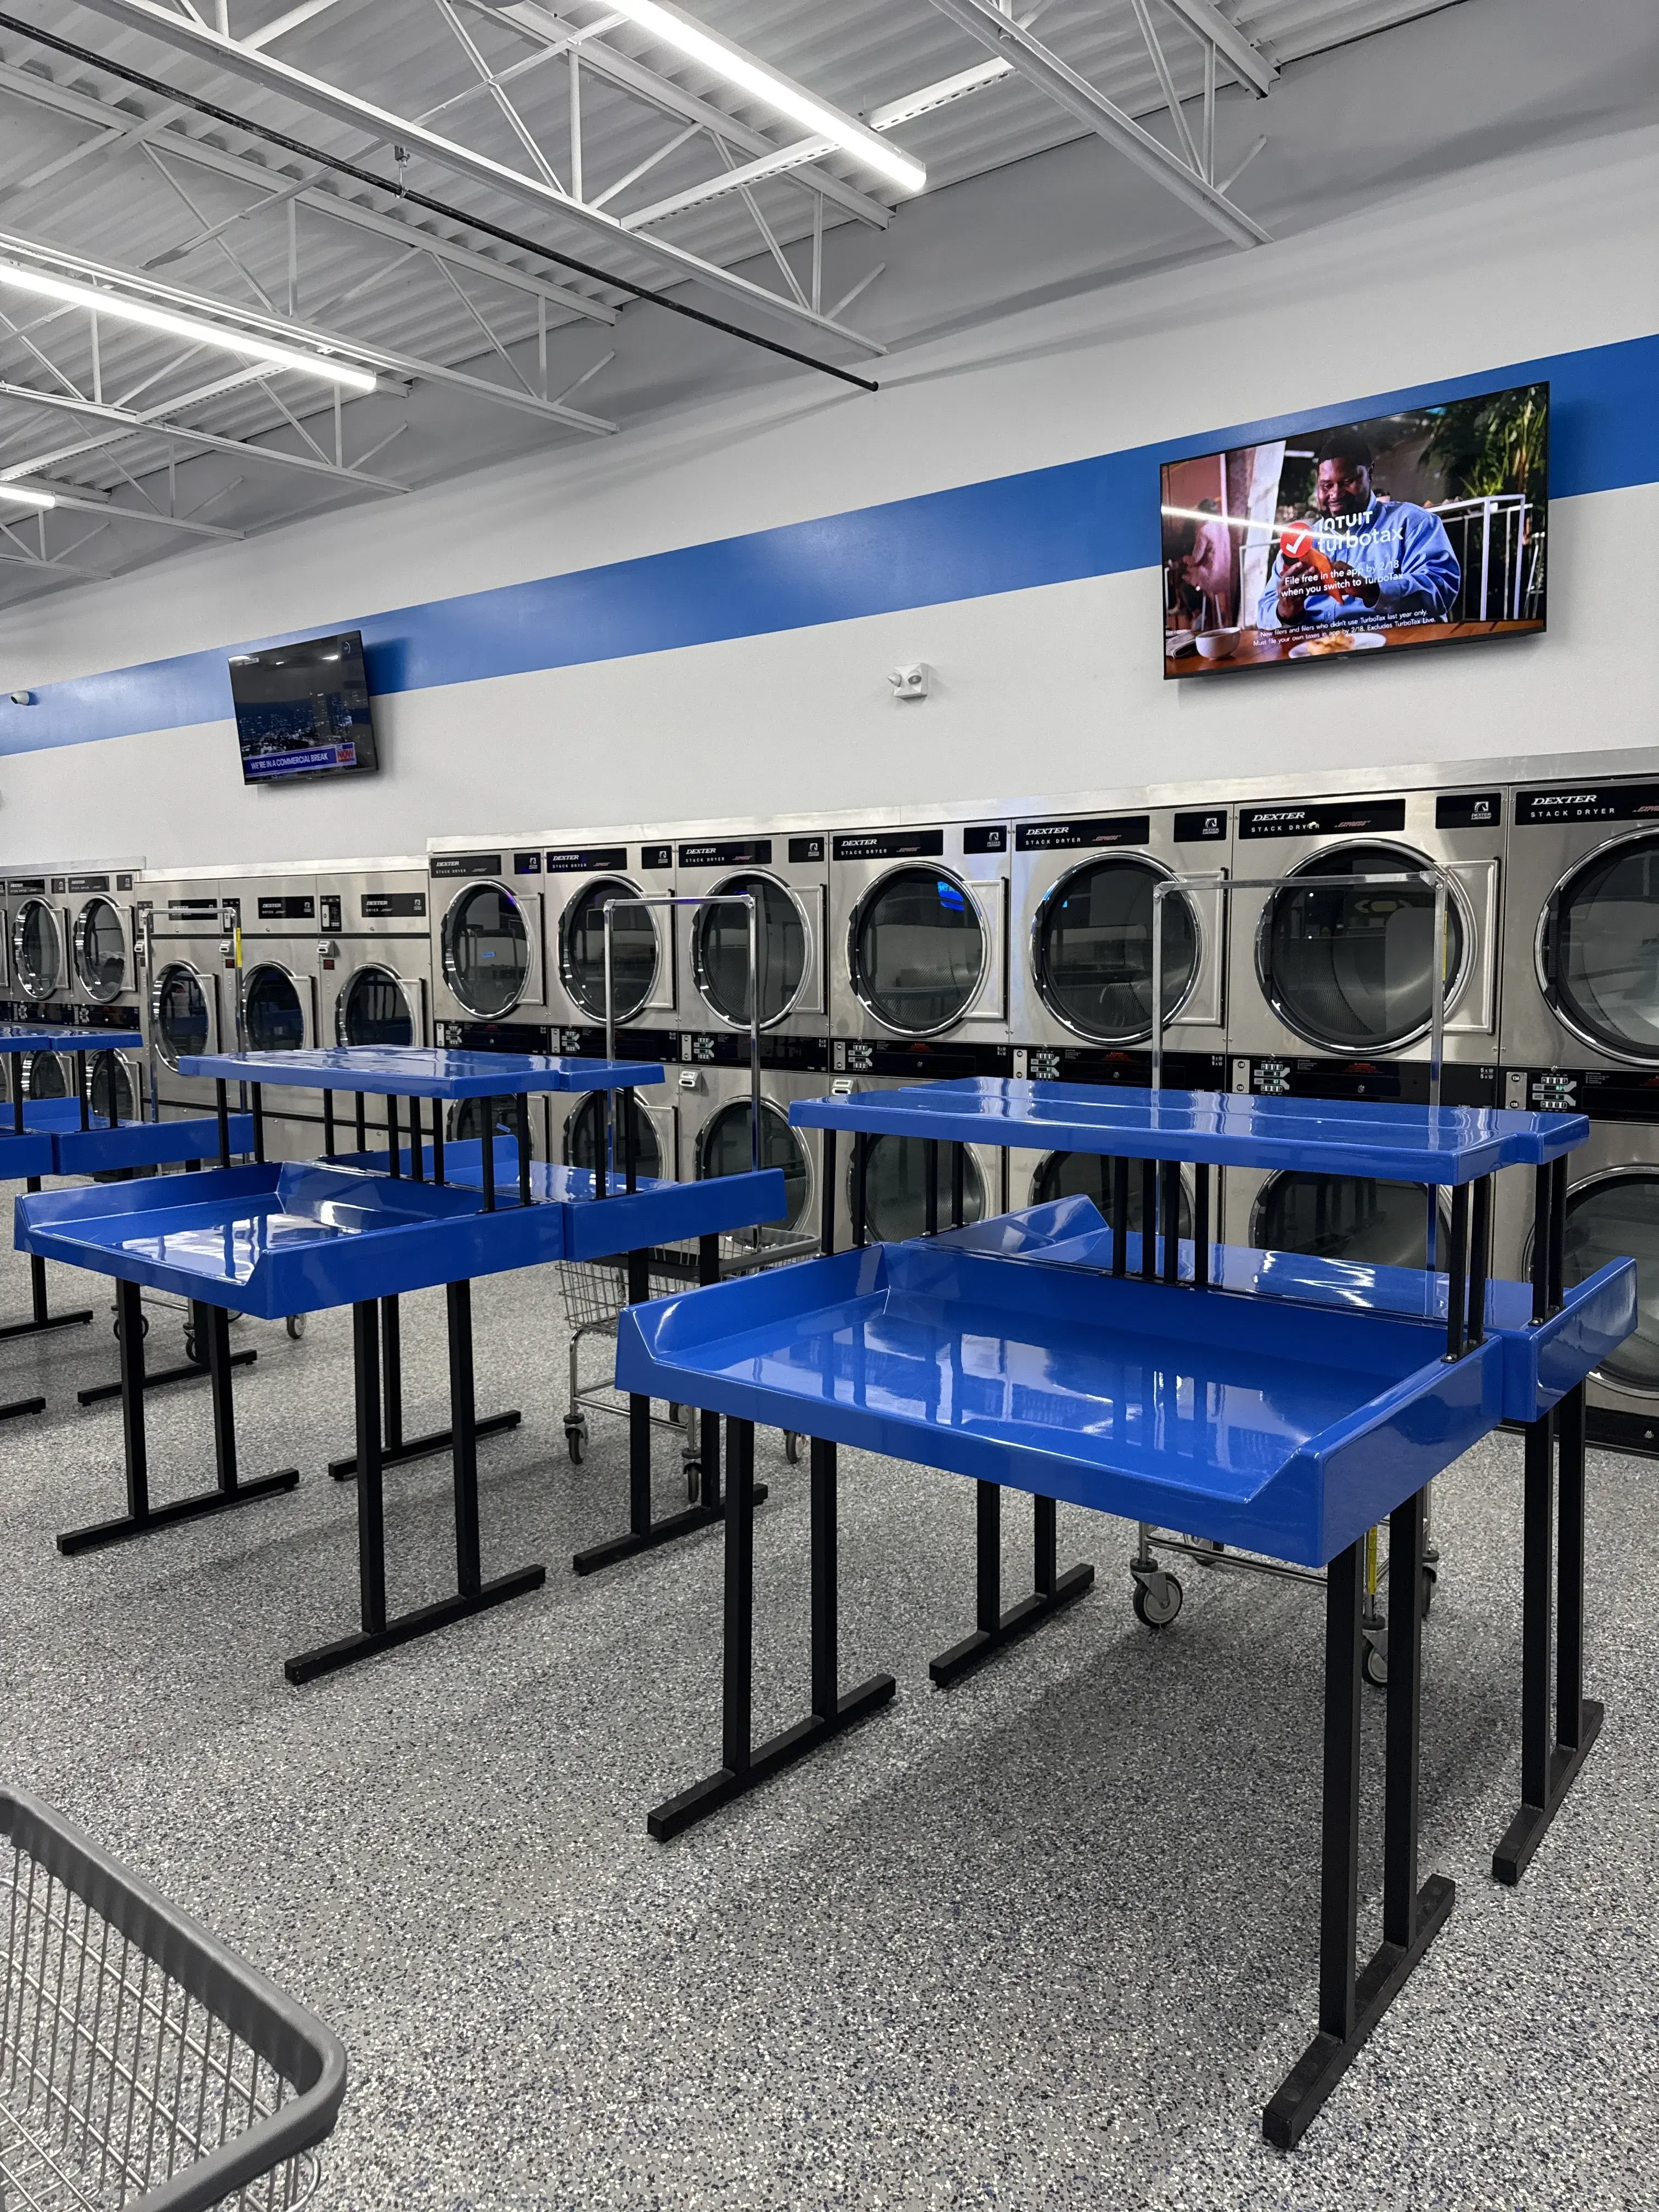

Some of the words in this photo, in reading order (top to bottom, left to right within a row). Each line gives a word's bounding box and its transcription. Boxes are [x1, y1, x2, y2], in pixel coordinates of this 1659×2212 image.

[1319, 511, 1373, 532] INTUIT
[1318, 527, 1403, 552] turbotax
[1285, 577, 1300, 585] File
[1302, 573, 1318, 582] free
[1321, 571, 1328, 580] in
[1330, 568, 1344, 578] the
[1347, 567, 1363, 577] app
[1366, 564, 1376, 574] by
[1379, 560, 1399, 571] 2/18
[1281, 588, 1304, 597] when
[1306, 585, 1321, 596] you
[1323, 579, 1350, 590] switch
[1364, 572, 1403, 585] TurboTax
[1360, 615, 1386, 623] TurboTax
[1399, 612, 1412, 620] year
[1329, 630, 1340, 639] app
[1367, 622, 1393, 630] Excludes
[1394, 618, 1421, 627] TurboTax
[276, 755, 311, 766] COMMERCIAL
[311, 752, 329, 763] BREAK
[337, 749, 354, 760] NOW
[1531, 795, 1597, 805] DEXTER
[1251, 812, 1306, 822] DEXTER
[1026, 827, 1069, 836] DEXTER
